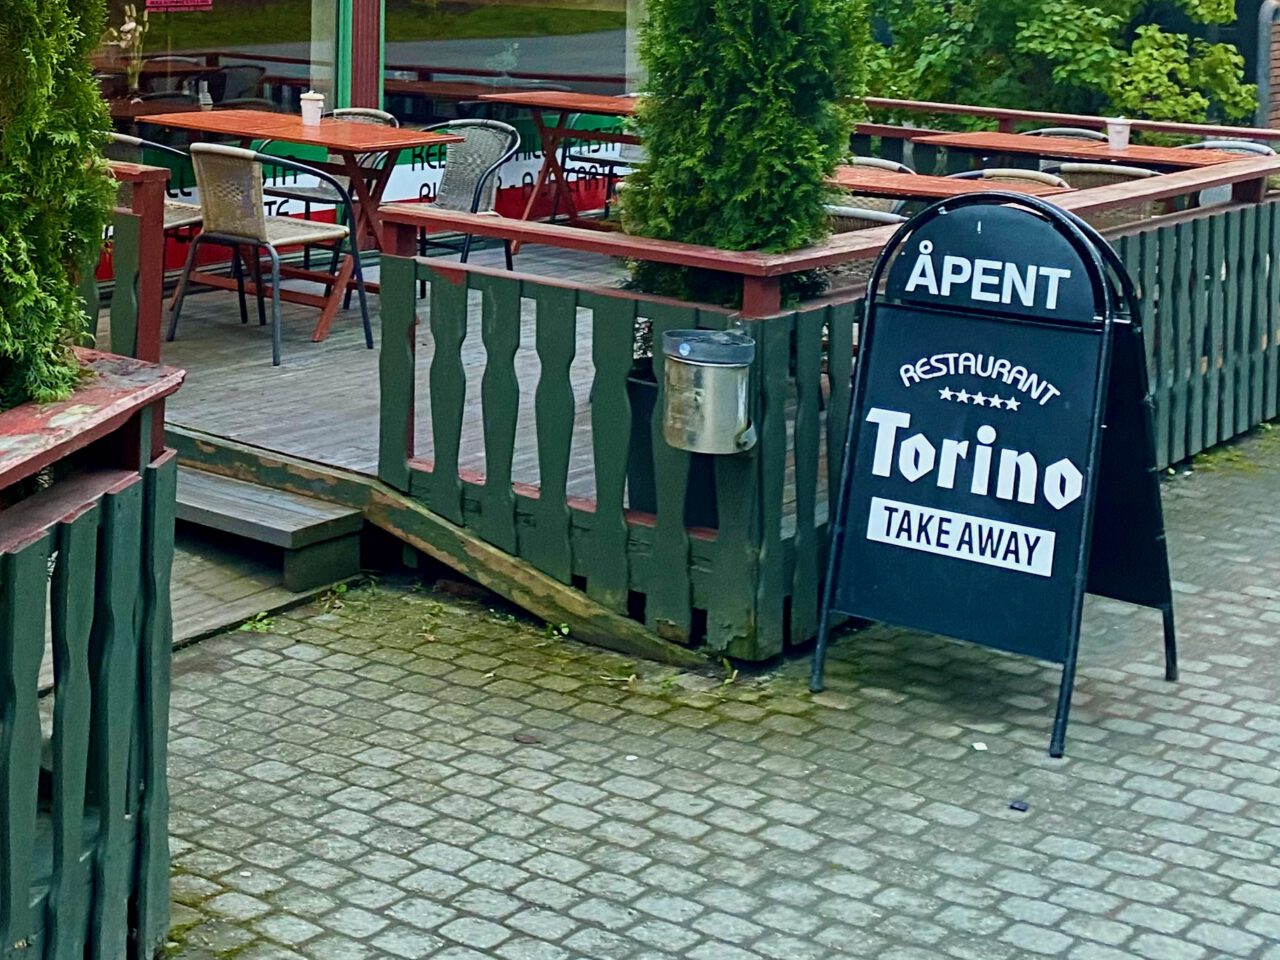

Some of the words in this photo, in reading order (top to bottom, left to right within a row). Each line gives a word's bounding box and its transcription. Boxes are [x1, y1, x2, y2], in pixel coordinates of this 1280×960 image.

[905, 239, 1072, 310] ÅPENT
[899, 352, 1061, 406] RESTAURANT
[865, 407, 1083, 510] Torino
[883, 505, 952, 549] TAKE
[956, 522, 1041, 566] AWAY
